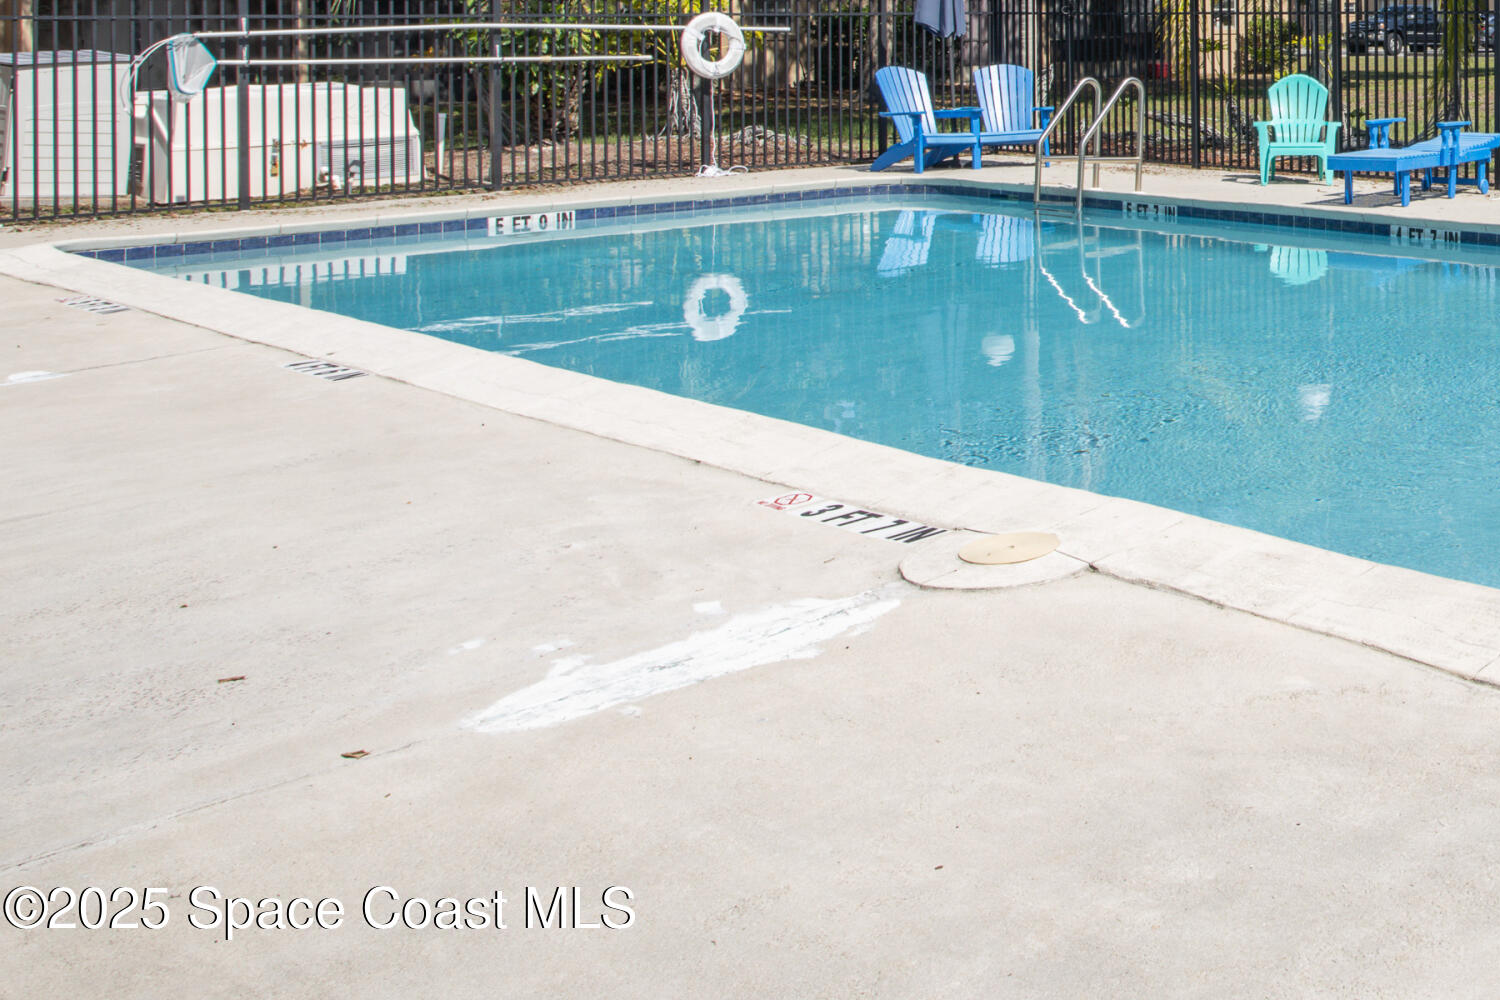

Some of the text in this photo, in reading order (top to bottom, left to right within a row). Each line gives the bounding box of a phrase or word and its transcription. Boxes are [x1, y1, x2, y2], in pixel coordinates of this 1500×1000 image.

[1408, 227, 1424, 239] FT
[1444, 231, 1458, 243] IN
[800, 503, 845, 517] 3
[820, 509, 884, 527] FT
[884, 525, 948, 544] IN
